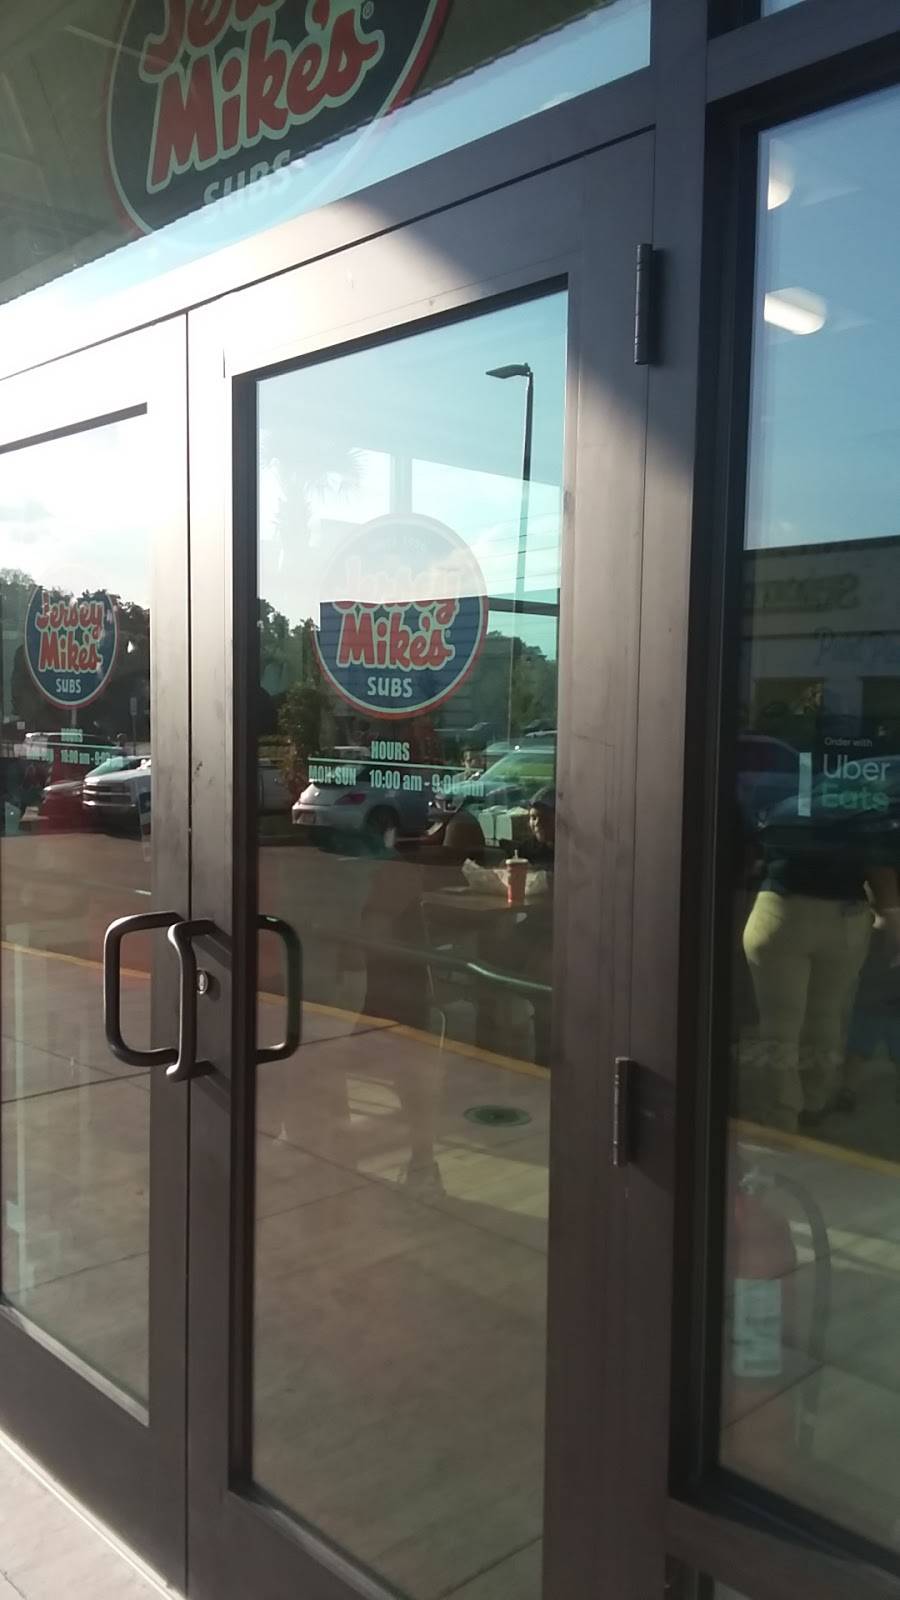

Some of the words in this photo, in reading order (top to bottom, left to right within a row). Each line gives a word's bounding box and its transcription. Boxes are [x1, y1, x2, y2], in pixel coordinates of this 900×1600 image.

[35, 591, 104, 640] Jersey
[336, 606, 455, 671] Mike's
[39, 629, 103, 674] Mike's
[56, 678, 82, 694] SUBS
[367, 676, 413, 698] SUBS
[371, 741, 410, 762] HOURS
[824, 737, 851, 747] Order
[853, 738, 873, 748] with
[823, 753, 891, 781] Uber
[369, 769, 400, 789] 10:00
[402, 774, 422, 792] am
[822, 782, 890, 811] Eats
